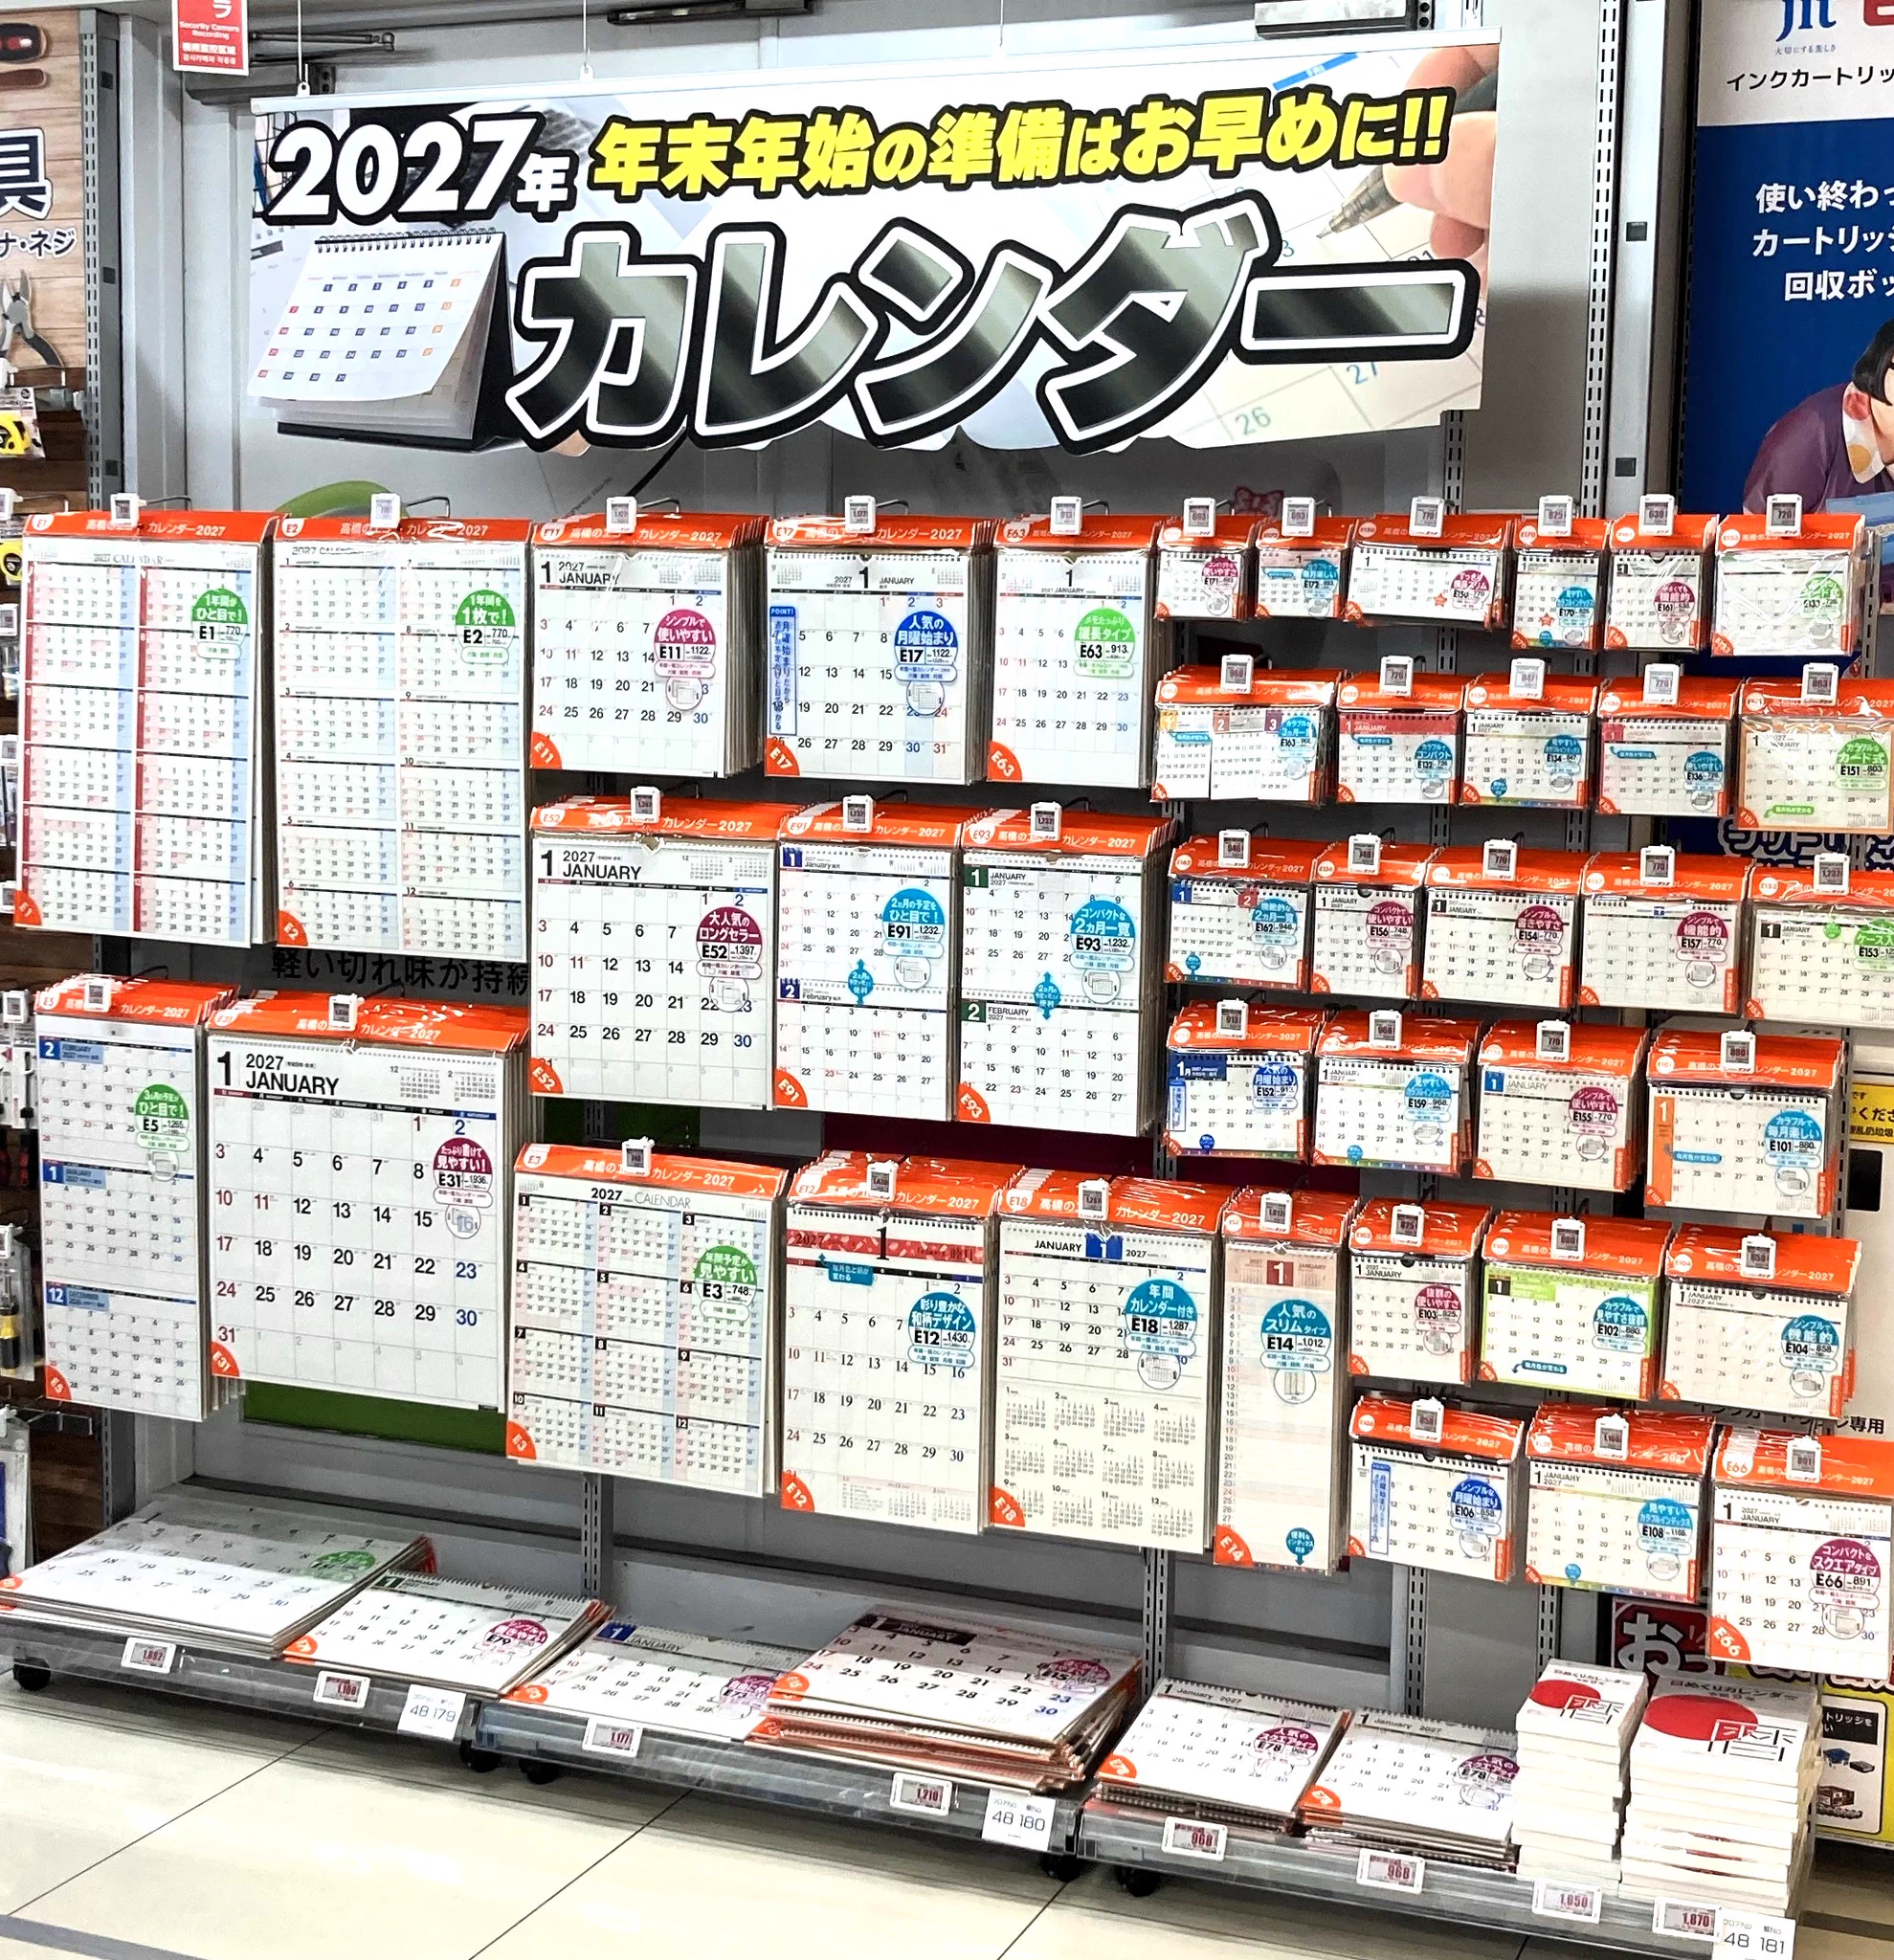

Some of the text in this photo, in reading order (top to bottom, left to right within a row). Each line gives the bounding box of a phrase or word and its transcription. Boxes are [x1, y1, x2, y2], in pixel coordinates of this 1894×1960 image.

[179, 21, 240, 33] Security Camera
[191, 30, 231, 40] Recording
[265, 91, 1448, 220] 2027年 年末年始の準備はお早めに!!
[505, 193, 1479, 451] カレンダー
[148, 523, 225, 536] カレンダー2027
[638, 527, 722, 542] カレンダー2027
[878, 527, 962, 541] カレンダー2027
[1007, 528, 1026, 539] E63
[559, 562, 585, 571] 2027
[462, 608, 507, 625] 1枚で!
[666, 616, 705, 627] シンプルで
[909, 615, 944, 630] 人気の
[199, 626, 241, 640] E1 770
[463, 629, 507, 644] E2 770
[657, 629, 712, 641] 使いやすい
[898, 631, 953, 646] 月曜始まり
[659, 646, 681, 659] E11
[900, 649, 923, 662] E17
[1080, 644, 1126, 658] E63 913
[1280, 738, 1296, 747] E163
[1417, 751, 1452, 760] コンパクト
[1546, 754, 1562, 763] E134
[1837, 750, 1886, 765] カード式
[1417, 760, 1434, 768] E132
[1686, 771, 1704, 781] E136
[1840, 766, 1860, 777] E151
[662, 817, 752, 832] カレンダー2027
[789, 820, 808, 831] E91
[875, 825, 946, 838] カレンダー2027
[973, 830, 991, 840] E93
[1062, 834, 1136, 849] カレンダー2027
[563, 851, 595, 862] 2027
[563, 865, 641, 880] JANUARY
[990, 872, 1027, 881] JANUARY
[1081, 908, 1126, 920] コンパクトな
[1448, 906, 1477, 915] JANUARY
[709, 911, 749, 927] 大人気の
[1368, 914, 1413, 925] 使いやすい
[699, 926, 760, 943] ロングセラー
[887, 924, 911, 939] E91
[1256, 924, 1274, 933] E162
[1370, 926, 1390, 937] E156
[1518, 930, 1537, 941] E154
[1683, 924, 1722, 937] 機能的
[1076, 936, 1102, 951] E93
[1681, 939, 1701, 949] E157
[702, 945, 727, 959] E52
[1859, 947, 1879, 958] E153
[121, 1003, 189, 1018] カレンダー2027
[989, 1007, 1029, 1016] FEBRUARY
[361, 1022, 441, 1039] カレンダー2027
[246, 1054, 283, 1070] 2027
[1176, 1061, 1191, 1077] 1月
[246, 1071, 340, 1096] JANUARY
[1505, 1081, 1549, 1091] JANUARY
[1257, 1087, 1275, 1097] E152
[1408, 1099, 1426, 1108] E159
[1571, 1099, 1616, 1111] 使いやすい
[1572, 1111, 1593, 1122] E155
[143, 1118, 159, 1131] E5
[1767, 1125, 1819, 1139] 毎月楽しい
[1769, 1139, 1792, 1151] E101
[437, 1154, 487, 1172] 見やすい!
[439, 1172, 461, 1189] E31
[651, 1168, 735, 1186] カレンダー2027
[591, 1188, 691, 1208] 2027 CALENDAR
[895, 1191, 980, 1209] カレンダー2027
[1009, 1195, 1028, 1208] E18
[1115, 1207, 1205, 1225] カレンダー2027
[1035, 1240, 1147, 1258] JANUARY 2027
[700, 1262, 754, 1282] 見やすい
[1365, 1270, 1402, 1279] JANUARY
[49, 1288, 63, 1303] 12
[702, 1283, 749, 1300] E3 748
[1148, 1283, 1174, 1300] 年間
[1688, 1292, 1723, 1301] JANUARY
[920, 1299, 966, 1314] 彩り豊かな
[1130, 1298, 1194, 1318] カレンダー付き
[1279, 1304, 1316, 1320] 人気の
[912, 1310, 972, 1329] 和柄デザイン
[1418, 1309, 1437, 1320] E103
[1131, 1318, 1159, 1334] E18
[1266, 1319, 1326, 1335] スリムタイプ
[1597, 1324, 1619, 1337] E102
[915, 1329, 939, 1346] E12
[1267, 1336, 1294, 1351] E14
[1788, 1329, 1834, 1344] 機能的
[1785, 1343, 1808, 1354] E104
[1727, 1460, 1749, 1473] E66
[1544, 1472, 1581, 1482] JANUARY
[1454, 1493, 1499, 1509] 月曜始まり
[1454, 1505, 1475, 1519] E106
[1741, 1515, 1780, 1524] JANUARY
[1641, 1526, 1664, 1539] E108
[1822, 1546, 1872, 1560] コンパクトな
[1813, 1556, 1878, 1576] スクエアタイプ
[1816, 1572, 1871, 1589] E66 891
[485, 1635, 509, 1646] E79
[897, 1626, 956, 1641] JANUARY
[628, 1637, 681, 1653] JANUARY
[1176, 1688, 1214, 1700] January
[410, 1704, 457, 1723] 48 179
[1374, 1719, 1412, 1729] January
[1257, 1740, 1281, 1752] E78
[1461, 1768, 1487, 1779] E78
[992, 1810, 1046, 1832] 48 180
[1724, 1931, 1785, 1954] 48 181
